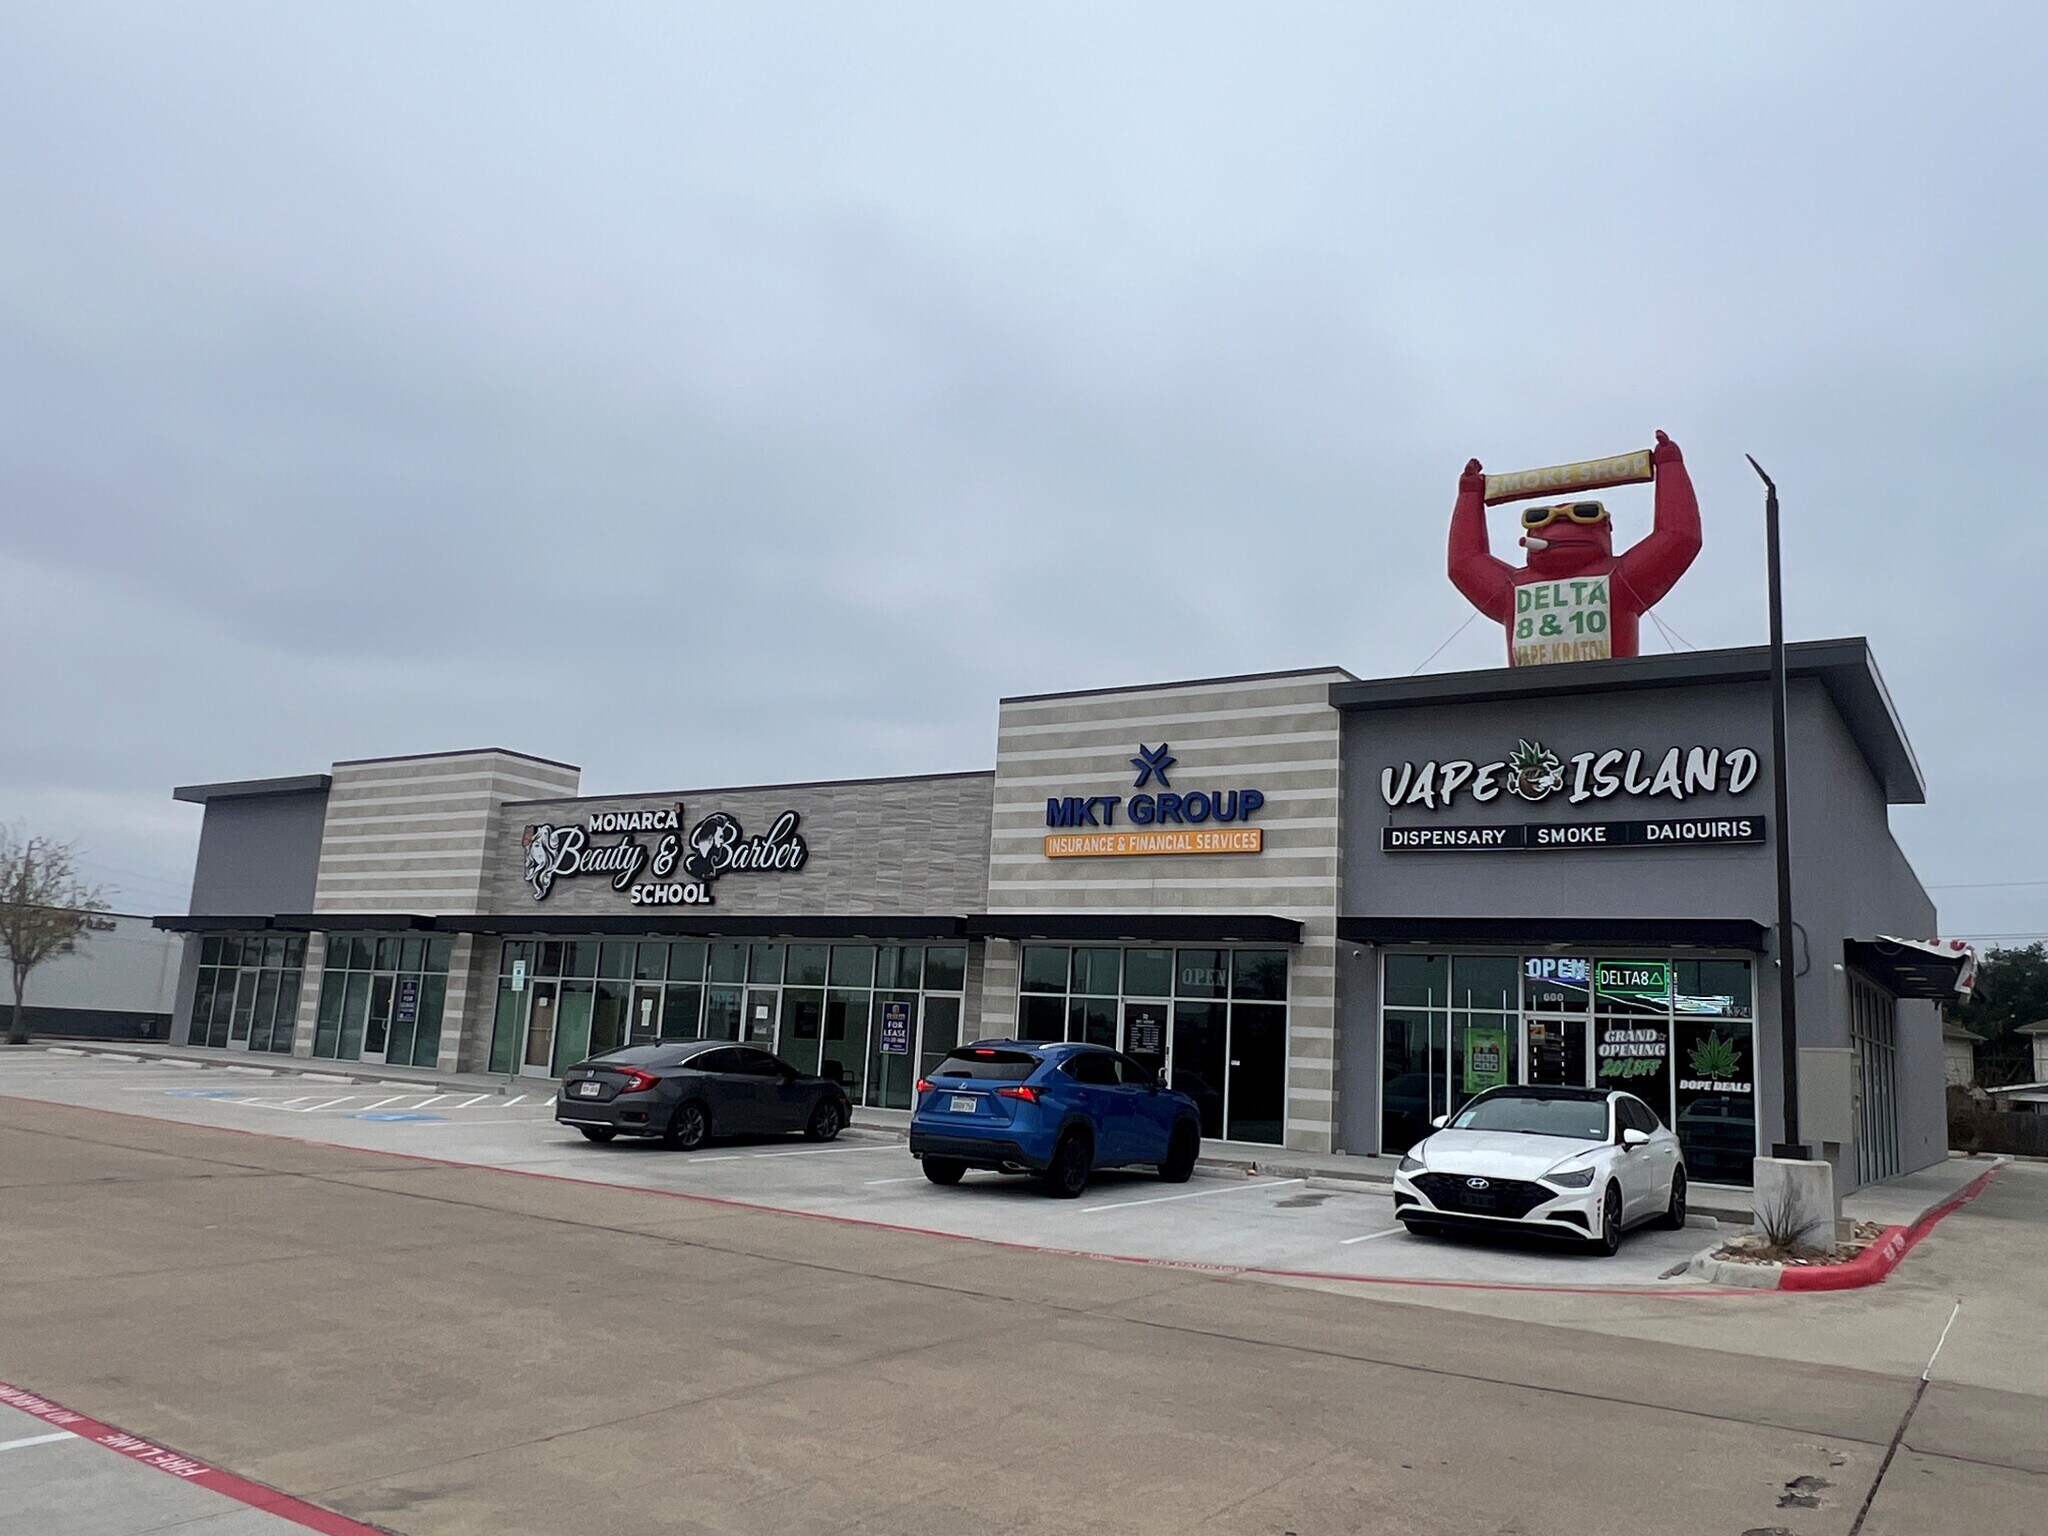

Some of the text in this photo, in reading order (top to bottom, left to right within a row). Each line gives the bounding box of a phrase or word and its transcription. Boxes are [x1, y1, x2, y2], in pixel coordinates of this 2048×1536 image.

[1488, 457, 1647, 493] SMOKE SHOP
[1517, 582, 1608, 613] DELTA
[1516, 610, 1607, 639] 8 & 10
[1381, 747, 1758, 809] VAPE ISLAND
[1046, 789, 1265, 827] MKT GROUP
[589, 810, 679, 832] MONARCA
[1049, 832, 1258, 853] INSURANCE & FINANCIAL SERVICES
[1391, 820, 1752, 846] DISPENSARY SMOKE DAIQUIRIS
[551, 812, 803, 889] Beauty & Barber
[630, 883, 710, 904] SCHOOL
[1182, 968, 1227, 986] OPEN
[1527, 958, 1587, 979] OPEN
[1601, 970, 1649, 985] DELTA8
[884, 1029, 905, 1037] LEASE
[1604, 1029, 1657, 1042] GRAND
[1598, 1043, 1666, 1056] OPENING
[1679, 1079, 1752, 1093] DOPE DEALS
[96, 1433, 210, 1477] FIRE LANE
